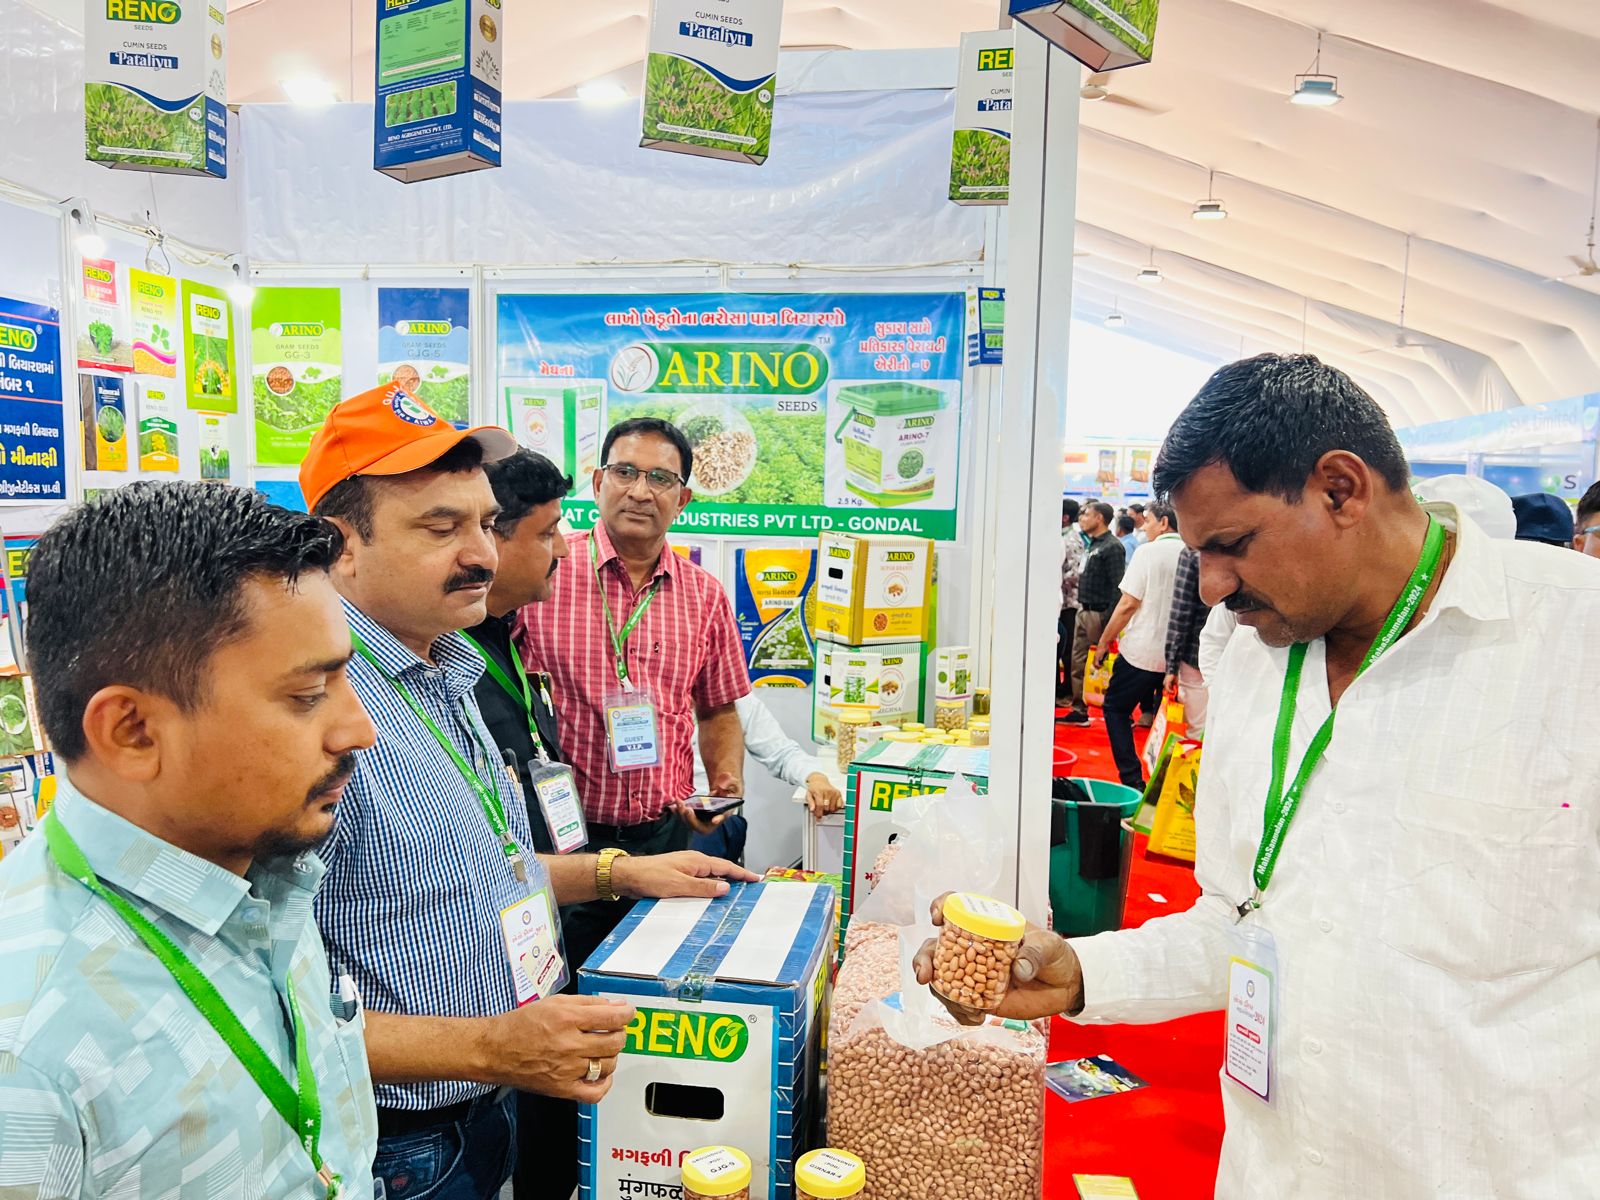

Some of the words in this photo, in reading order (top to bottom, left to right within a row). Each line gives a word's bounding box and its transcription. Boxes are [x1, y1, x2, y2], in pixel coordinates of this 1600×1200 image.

[108, 0, 177, 22] RENO
[695, 11, 718, 21] CUMIN
[720, 15, 743, 25] SEEDS
[686, 21, 747, 47] Pataliyu
[123, 41, 144, 49] CUMIN
[146, 42, 167, 50] SEEDS
[115, 51, 172, 71] Pataliyu
[85, 266, 111, 282] RENO
[138, 281, 162, 297] RENO
[197, 304, 220, 318] RENO
[284, 325, 322, 335] ARINO
[410, 323, 450, 333] ARINO
[658, 351, 820, 389] ARINO
[777, 400, 818, 413] SEEDS
[561, 507, 584, 522] AT
[672, 513, 759, 529] DUSTRIES
[764, 514, 798, 528] PVT
[802, 515, 834, 530] LTD
[848, 516, 923, 532] GONDAL
[888, 552, 915, 560] ARINO
[764, 572, 796, 580] ARINO
[624, 735, 644, 743] GUEST
[624, 1012, 744, 1059] RENO
[612, 1148, 671, 1167] મગફળી
